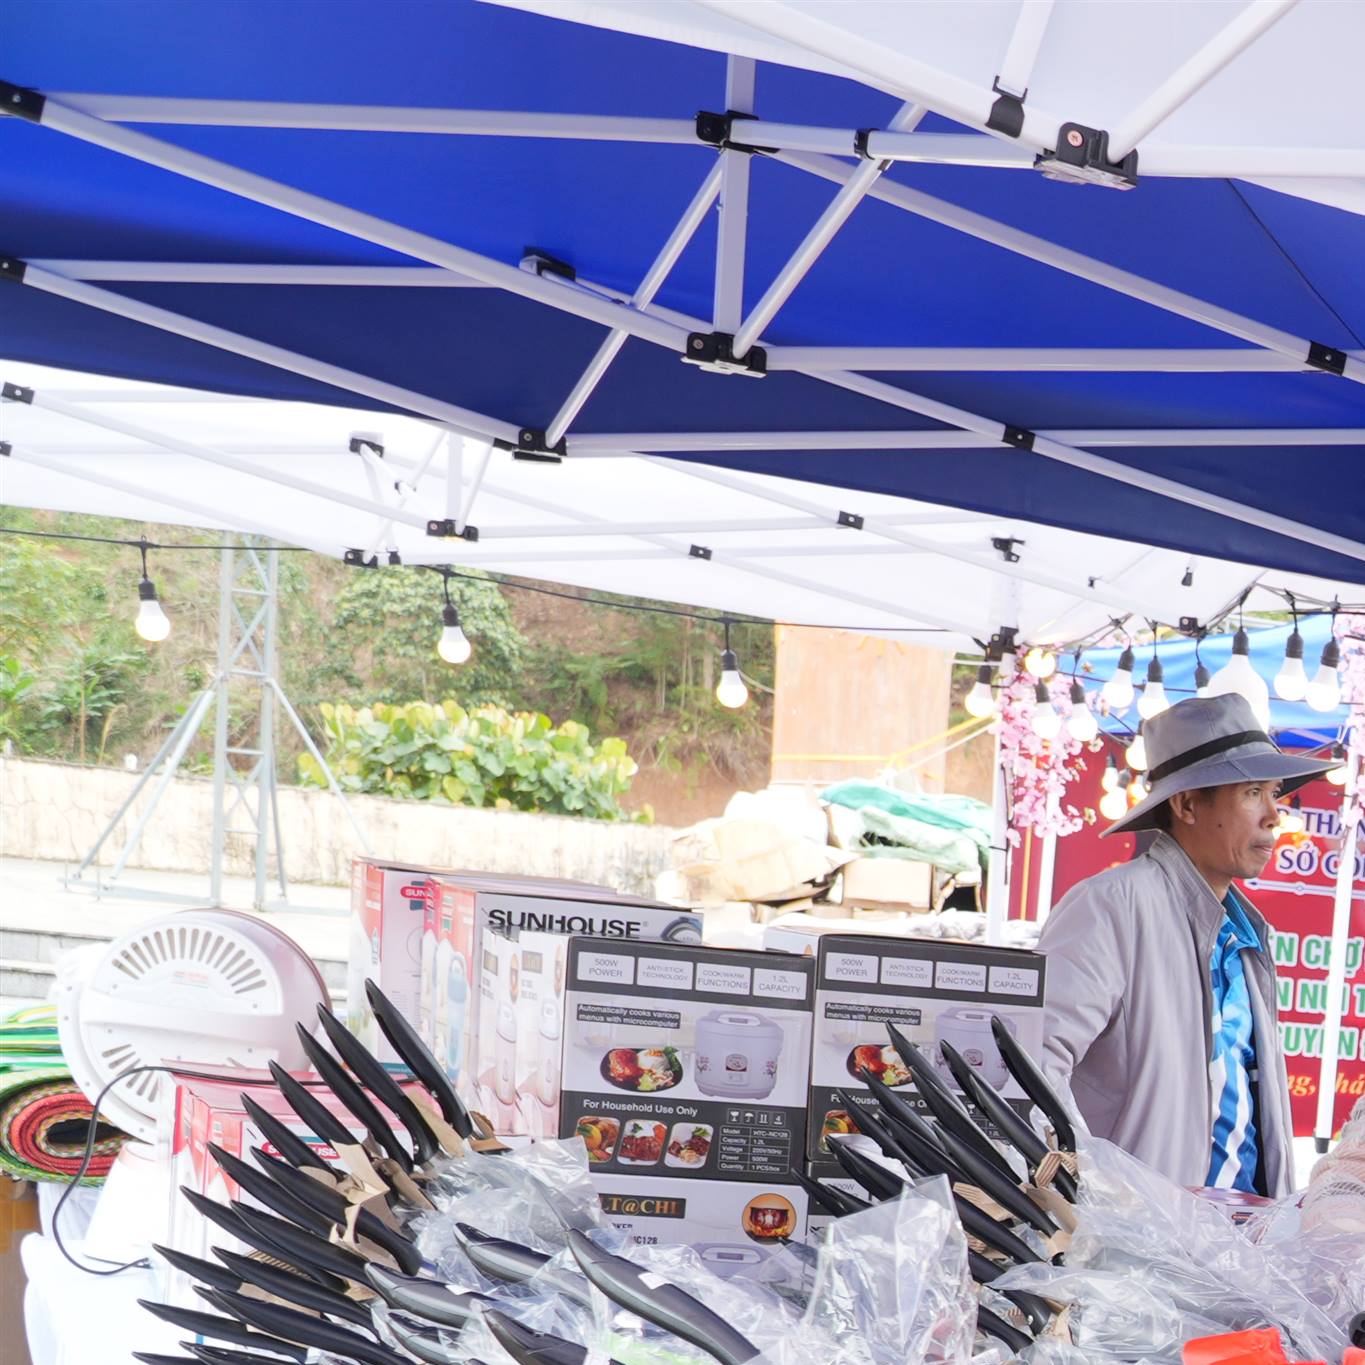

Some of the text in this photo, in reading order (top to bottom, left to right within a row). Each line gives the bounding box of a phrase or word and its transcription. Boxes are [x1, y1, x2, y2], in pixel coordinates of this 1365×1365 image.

[1279, 844, 1320, 872] SỞ
[488, 909, 641, 938] SUNHOUSE
[588, 966, 623, 977] POWER
[836, 967, 868, 977] POWER
[697, 978, 749, 989] FUNCTIONS
[937, 976, 984, 987] FUNCTIONS
[993, 980, 1033, 991] CAPACITY
[758, 982, 801, 994] CAPACITY
[578, 1004, 628, 1016] Automatically
[583, 1099, 698, 1117] For Household Use Only
